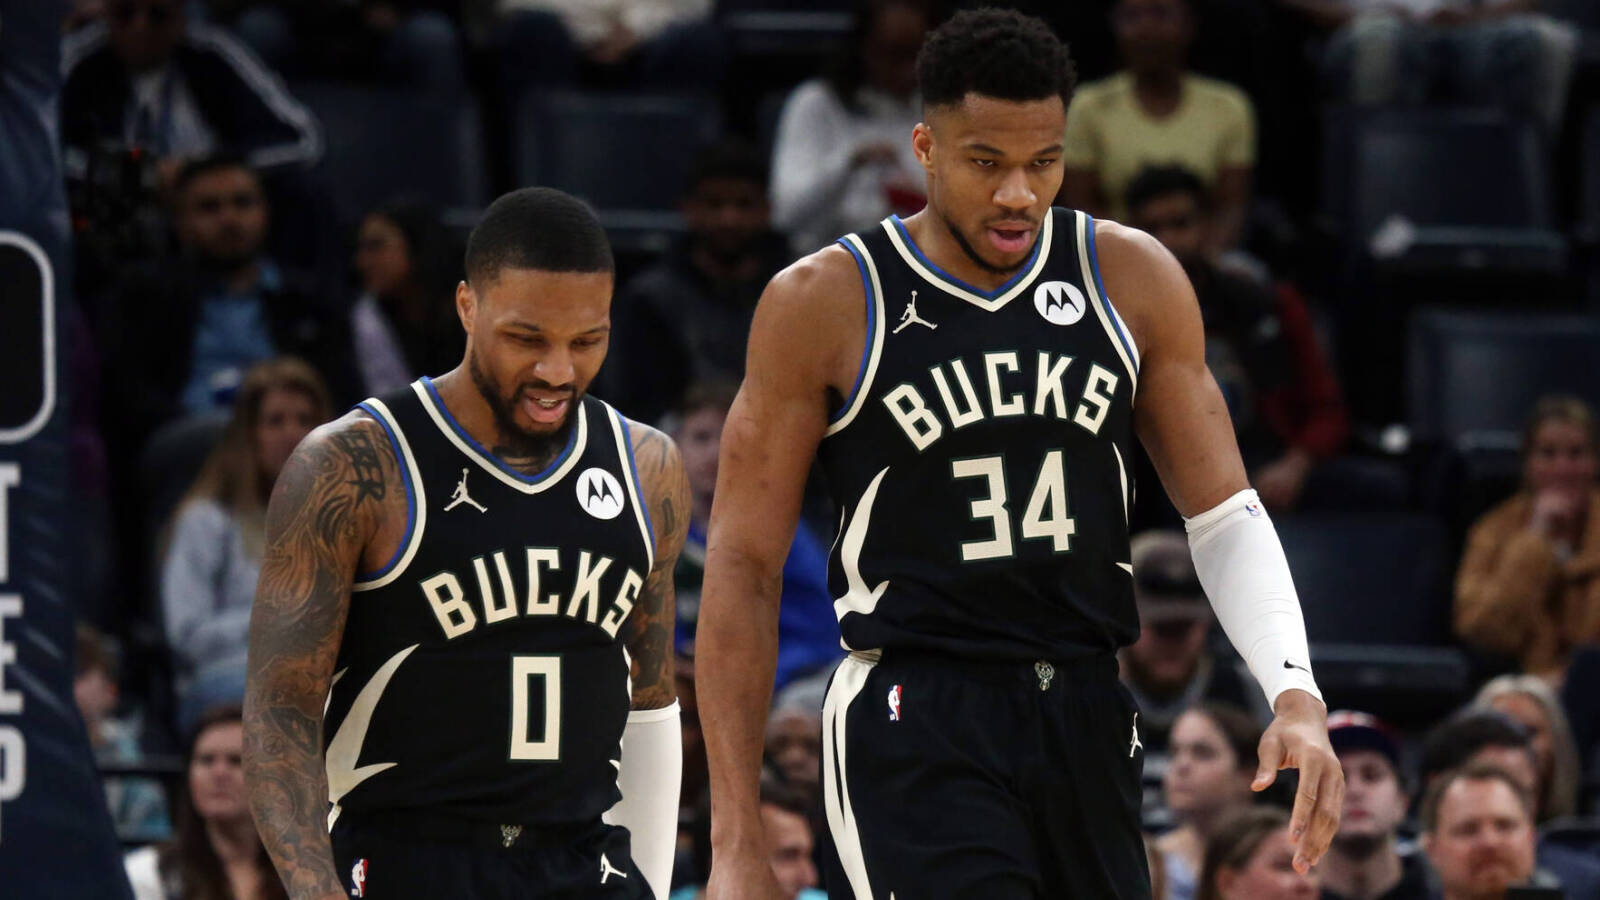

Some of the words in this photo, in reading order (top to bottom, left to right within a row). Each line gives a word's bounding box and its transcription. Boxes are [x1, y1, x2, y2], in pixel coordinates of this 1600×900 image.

[882, 351, 1119, 452] BUCKS
[951, 449, 1077, 562] 34
[420, 547, 644, 640] BUCKS
[509, 655, 562, 761] 0
